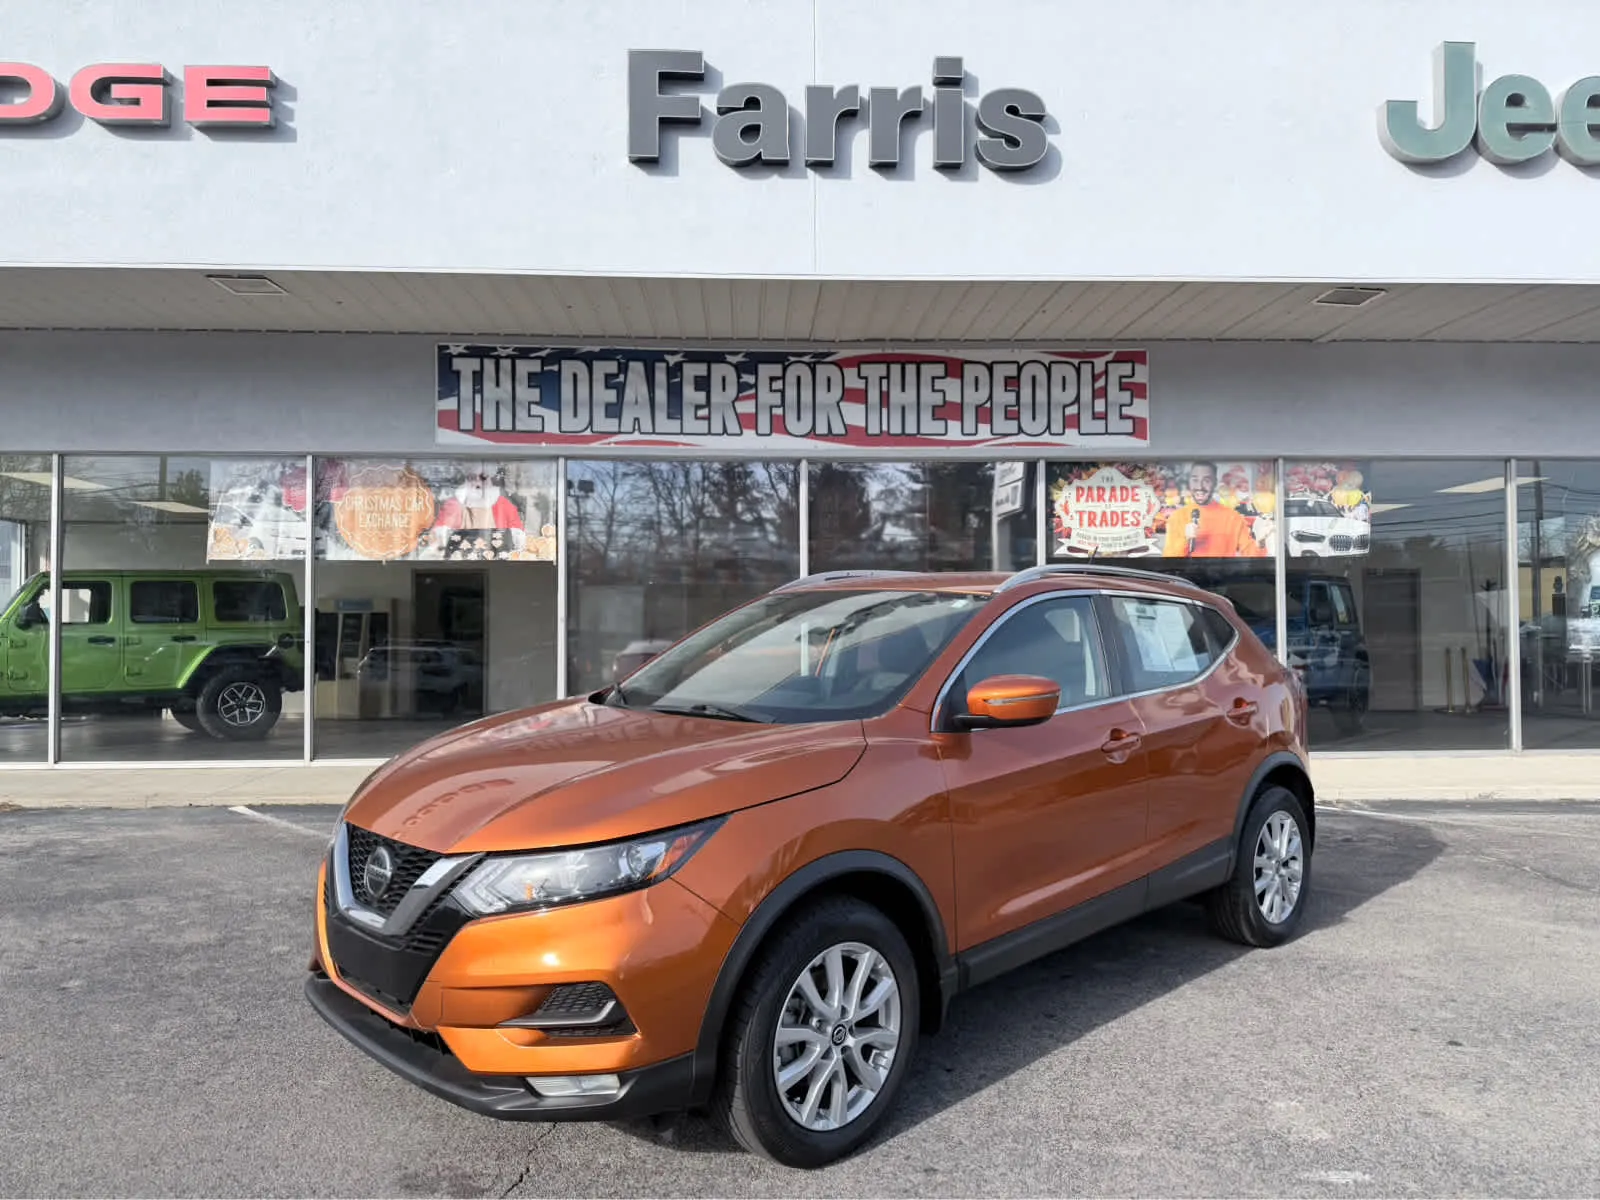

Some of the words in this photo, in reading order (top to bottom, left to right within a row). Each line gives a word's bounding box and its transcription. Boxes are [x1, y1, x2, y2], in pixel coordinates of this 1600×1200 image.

[627, 48, 1048, 170] Farris
[452, 357, 545, 432] THE
[558, 359, 743, 436] DEALER
[756, 360, 847, 436] FOR
[858, 361, 949, 436] THE
[961, 360, 1135, 436] PEOPLE
[345, 495, 402, 511] CHRISTMAS
[1075, 485, 1141, 503] PARADE
[359, 512, 409, 528] EXCHANGE
[1076, 510, 1142, 528] TRADES
